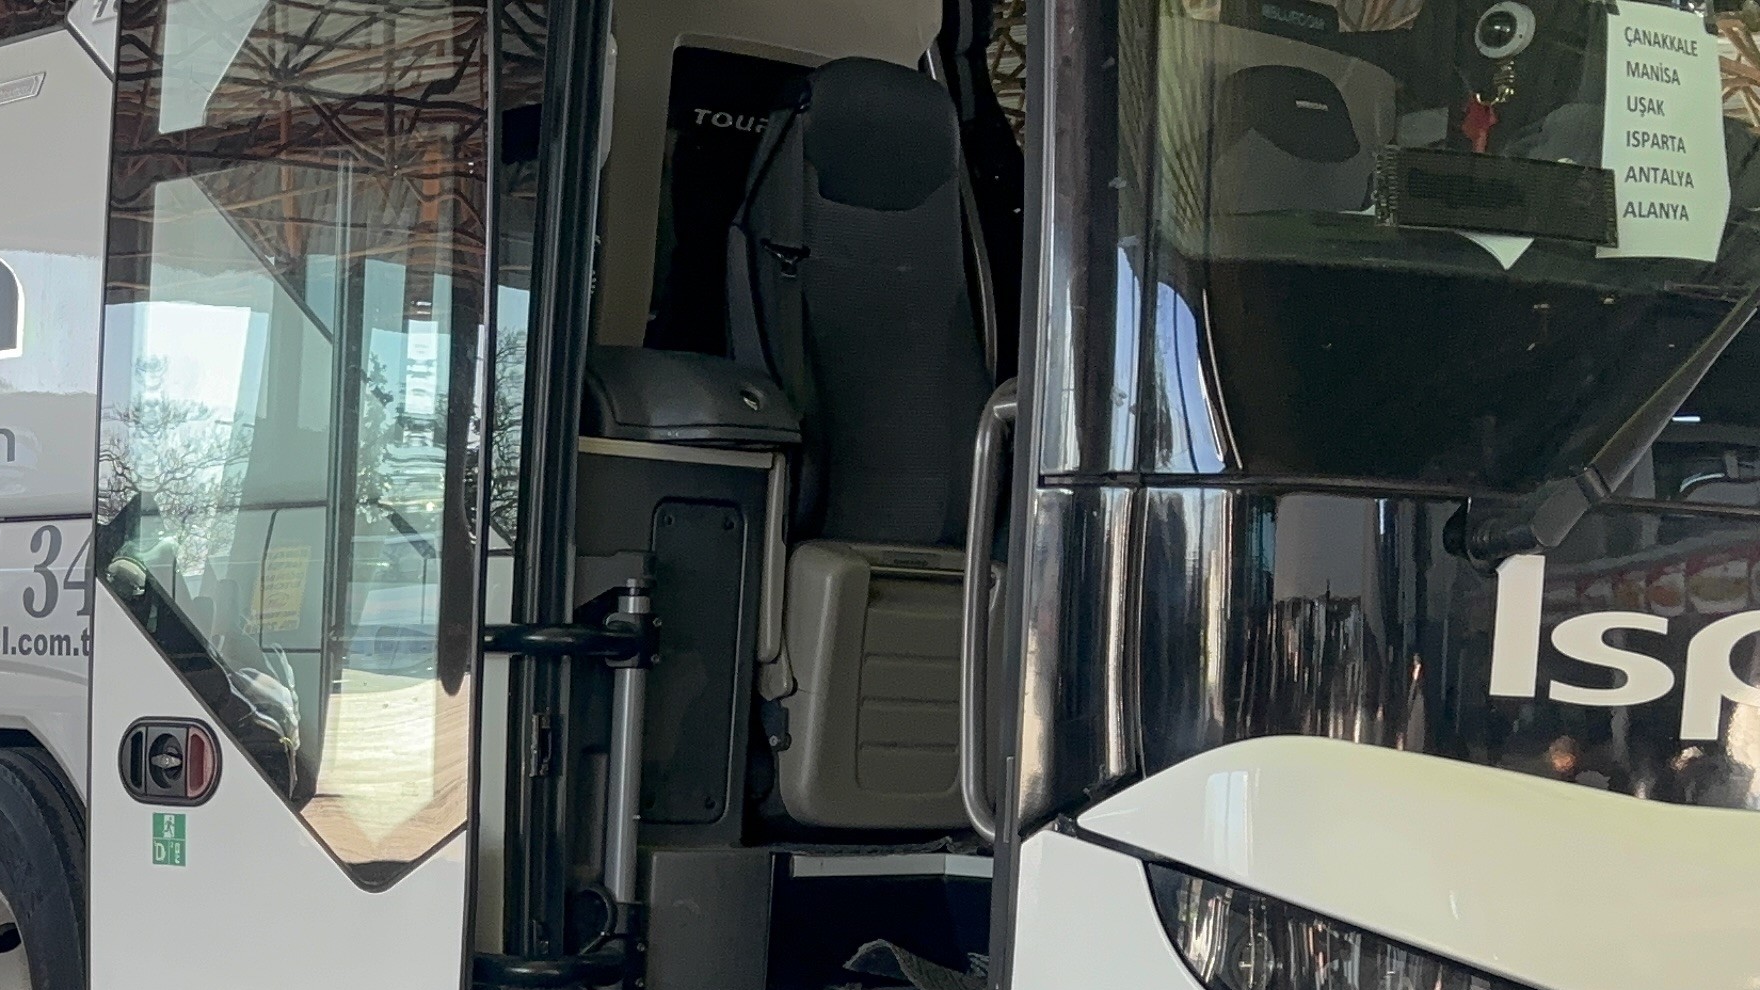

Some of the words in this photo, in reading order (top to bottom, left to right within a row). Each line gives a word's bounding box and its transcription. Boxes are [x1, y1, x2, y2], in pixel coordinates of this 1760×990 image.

[1624, 26, 1698, 57] ÇANAKKALE
[1626, 61, 1681, 86] MANİSA
[1626, 95, 1666, 117] UŞAK
[1626, 130, 1687, 154] ISPARTA
[1624, 165, 1695, 189] ANTALYA
[1622, 201, 1689, 222] ALANYA
[23, 524, 92, 618] 34
